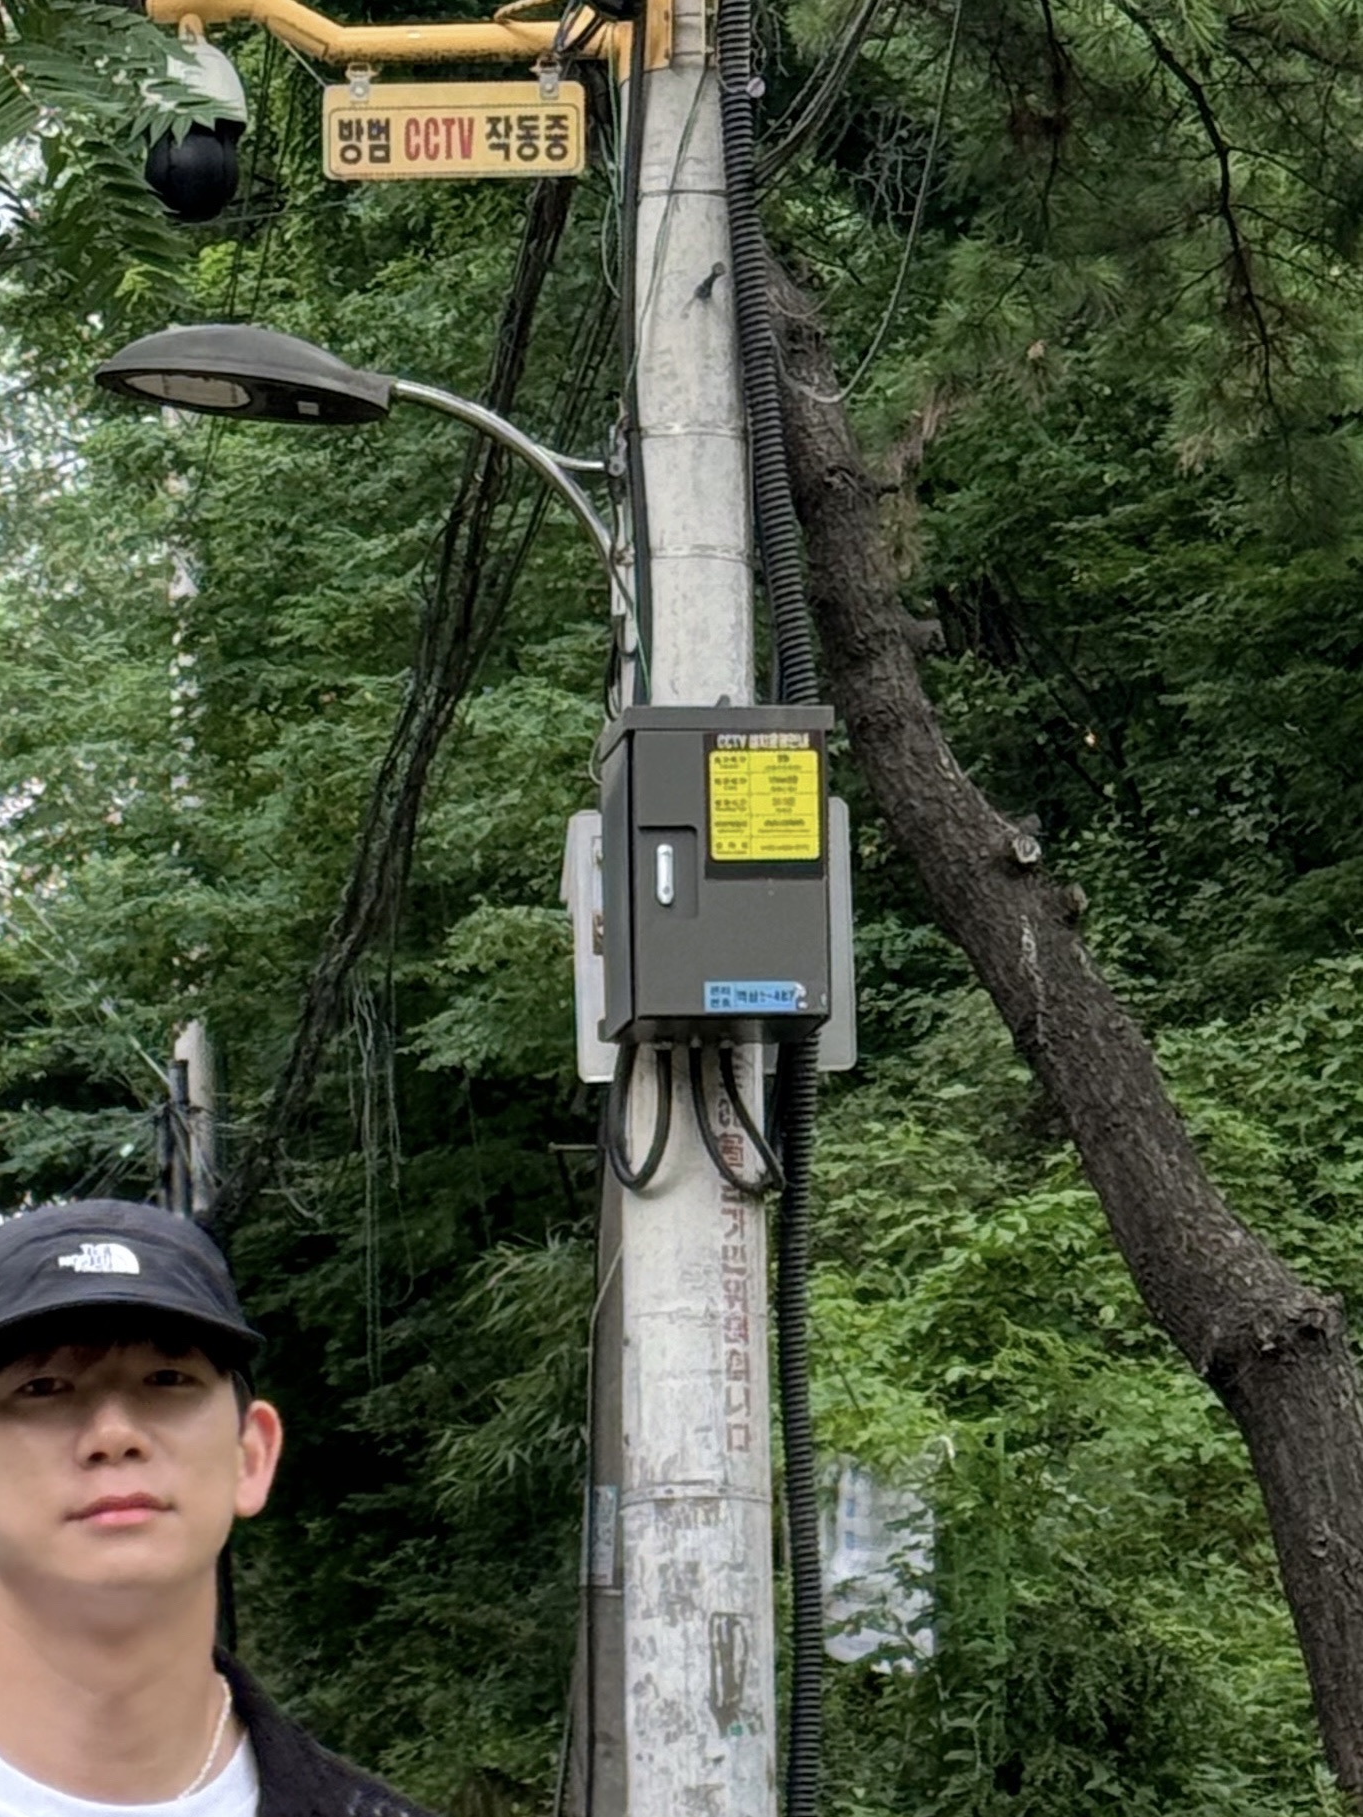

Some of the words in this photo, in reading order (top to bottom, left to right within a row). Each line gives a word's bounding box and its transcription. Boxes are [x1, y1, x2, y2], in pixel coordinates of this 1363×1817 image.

[338, 117, 391, 164] 방범
[404, 117, 475, 162] CCTV
[485, 115, 569, 162] 작동중
